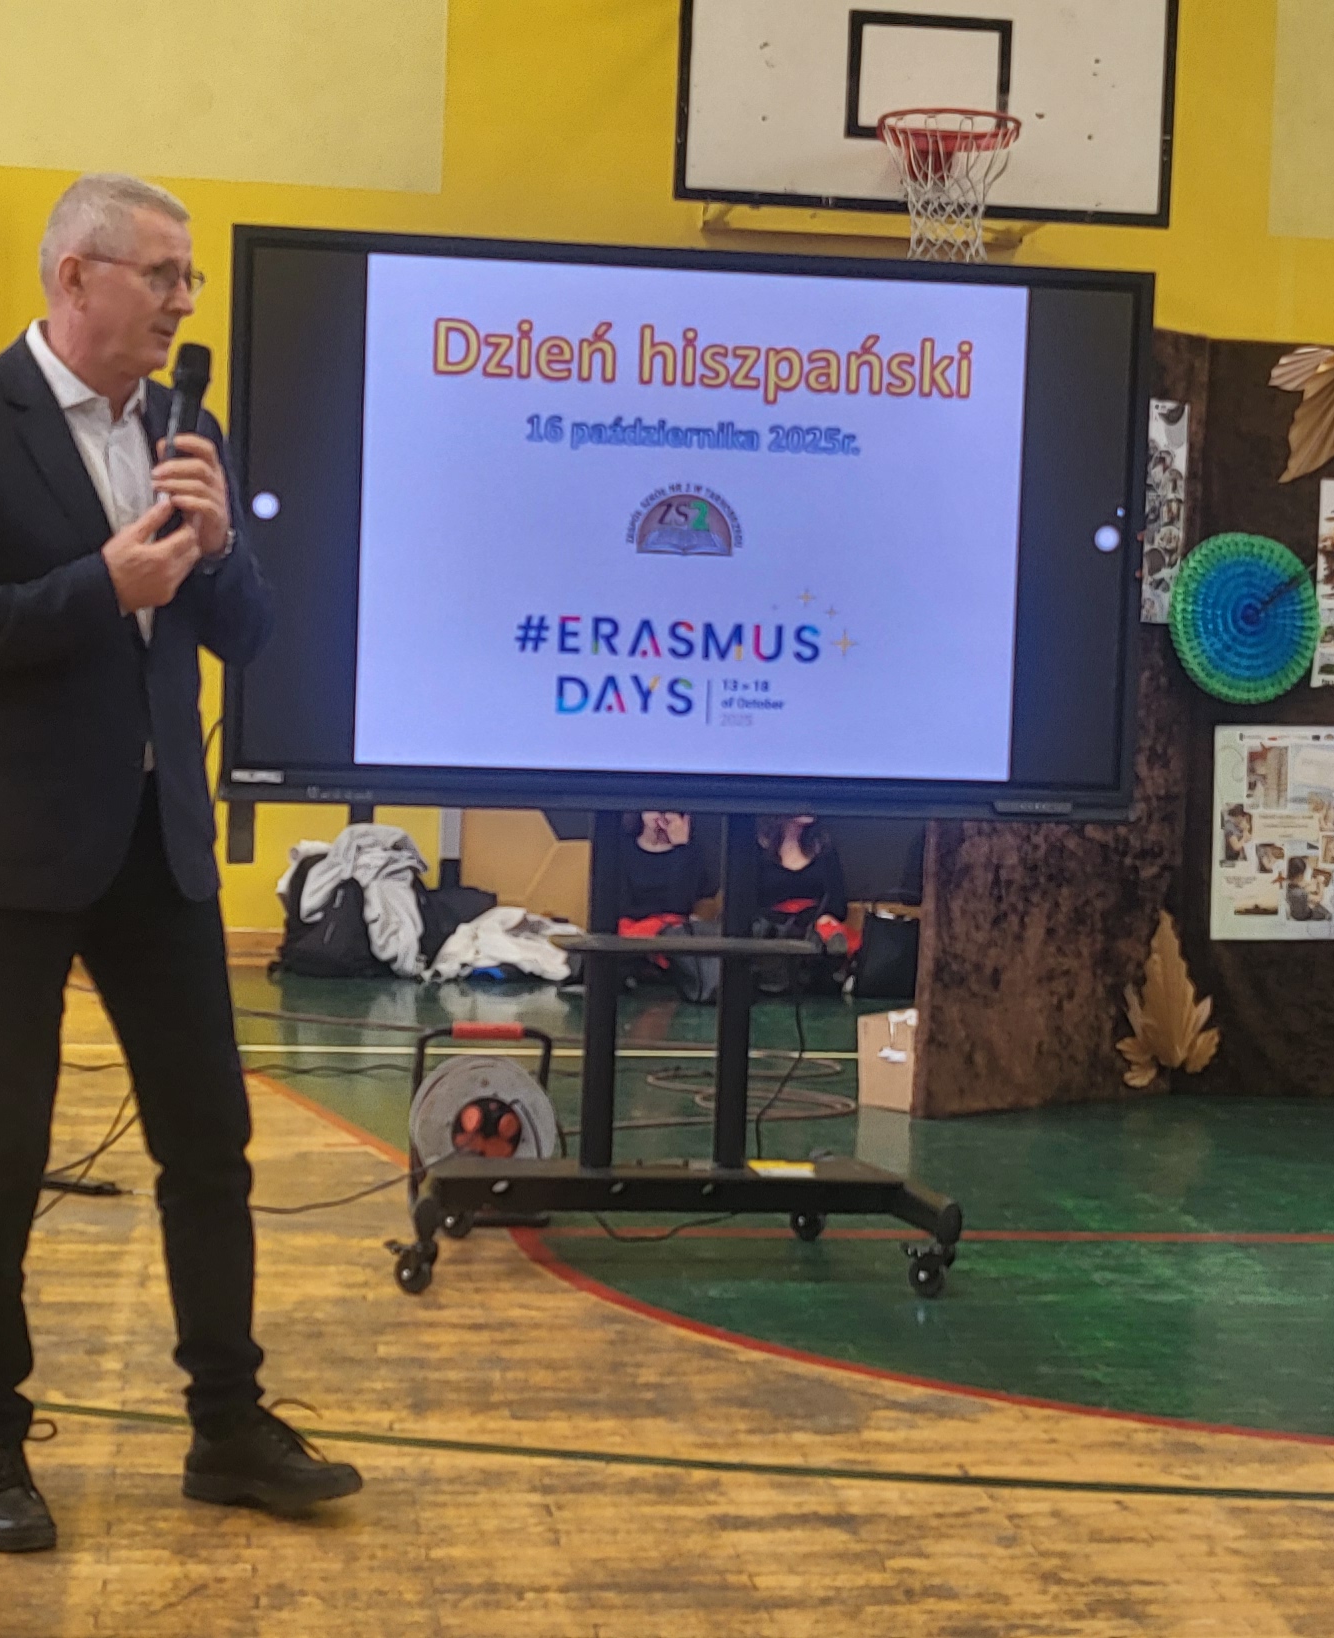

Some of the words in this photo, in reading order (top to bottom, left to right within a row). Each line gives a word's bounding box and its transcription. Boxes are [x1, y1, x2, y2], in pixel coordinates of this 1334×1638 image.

[433, 317, 617, 383] Dzień
[638, 323, 973, 405] hiszpański
[525, 413, 565, 443] 16
[570, 416, 760, 452] października
[767, 425, 861, 457] 2025r.
[515, 614, 821, 664] #ERASMUS
[555, 674, 695, 717] DAYS
[723, 679, 739, 692] 13
